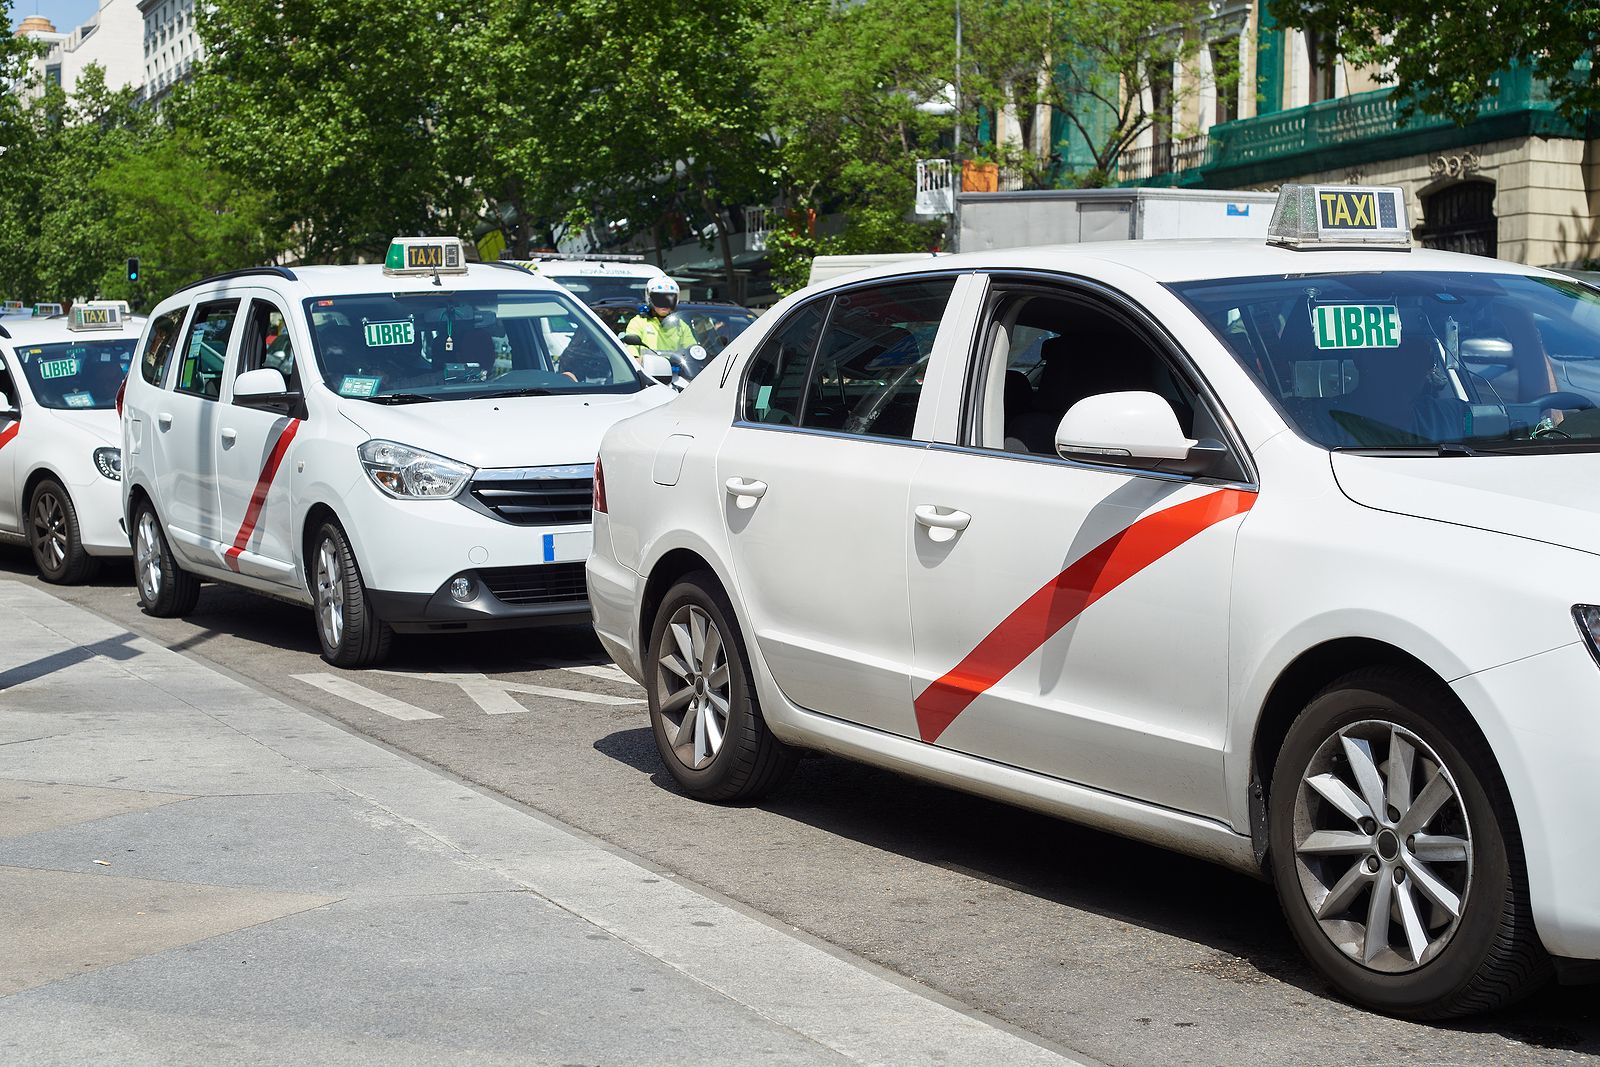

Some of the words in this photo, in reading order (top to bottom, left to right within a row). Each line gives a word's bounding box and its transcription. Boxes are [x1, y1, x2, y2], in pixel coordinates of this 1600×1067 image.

[1320, 193, 1376, 226] TAXI
[409, 248, 442, 265] TAXI
[84, 310, 108, 323] TAXI
[366, 323, 413, 345] LIBRE
[1317, 306, 1398, 348] LIBRE
[42, 359, 75, 378] LIBRE
